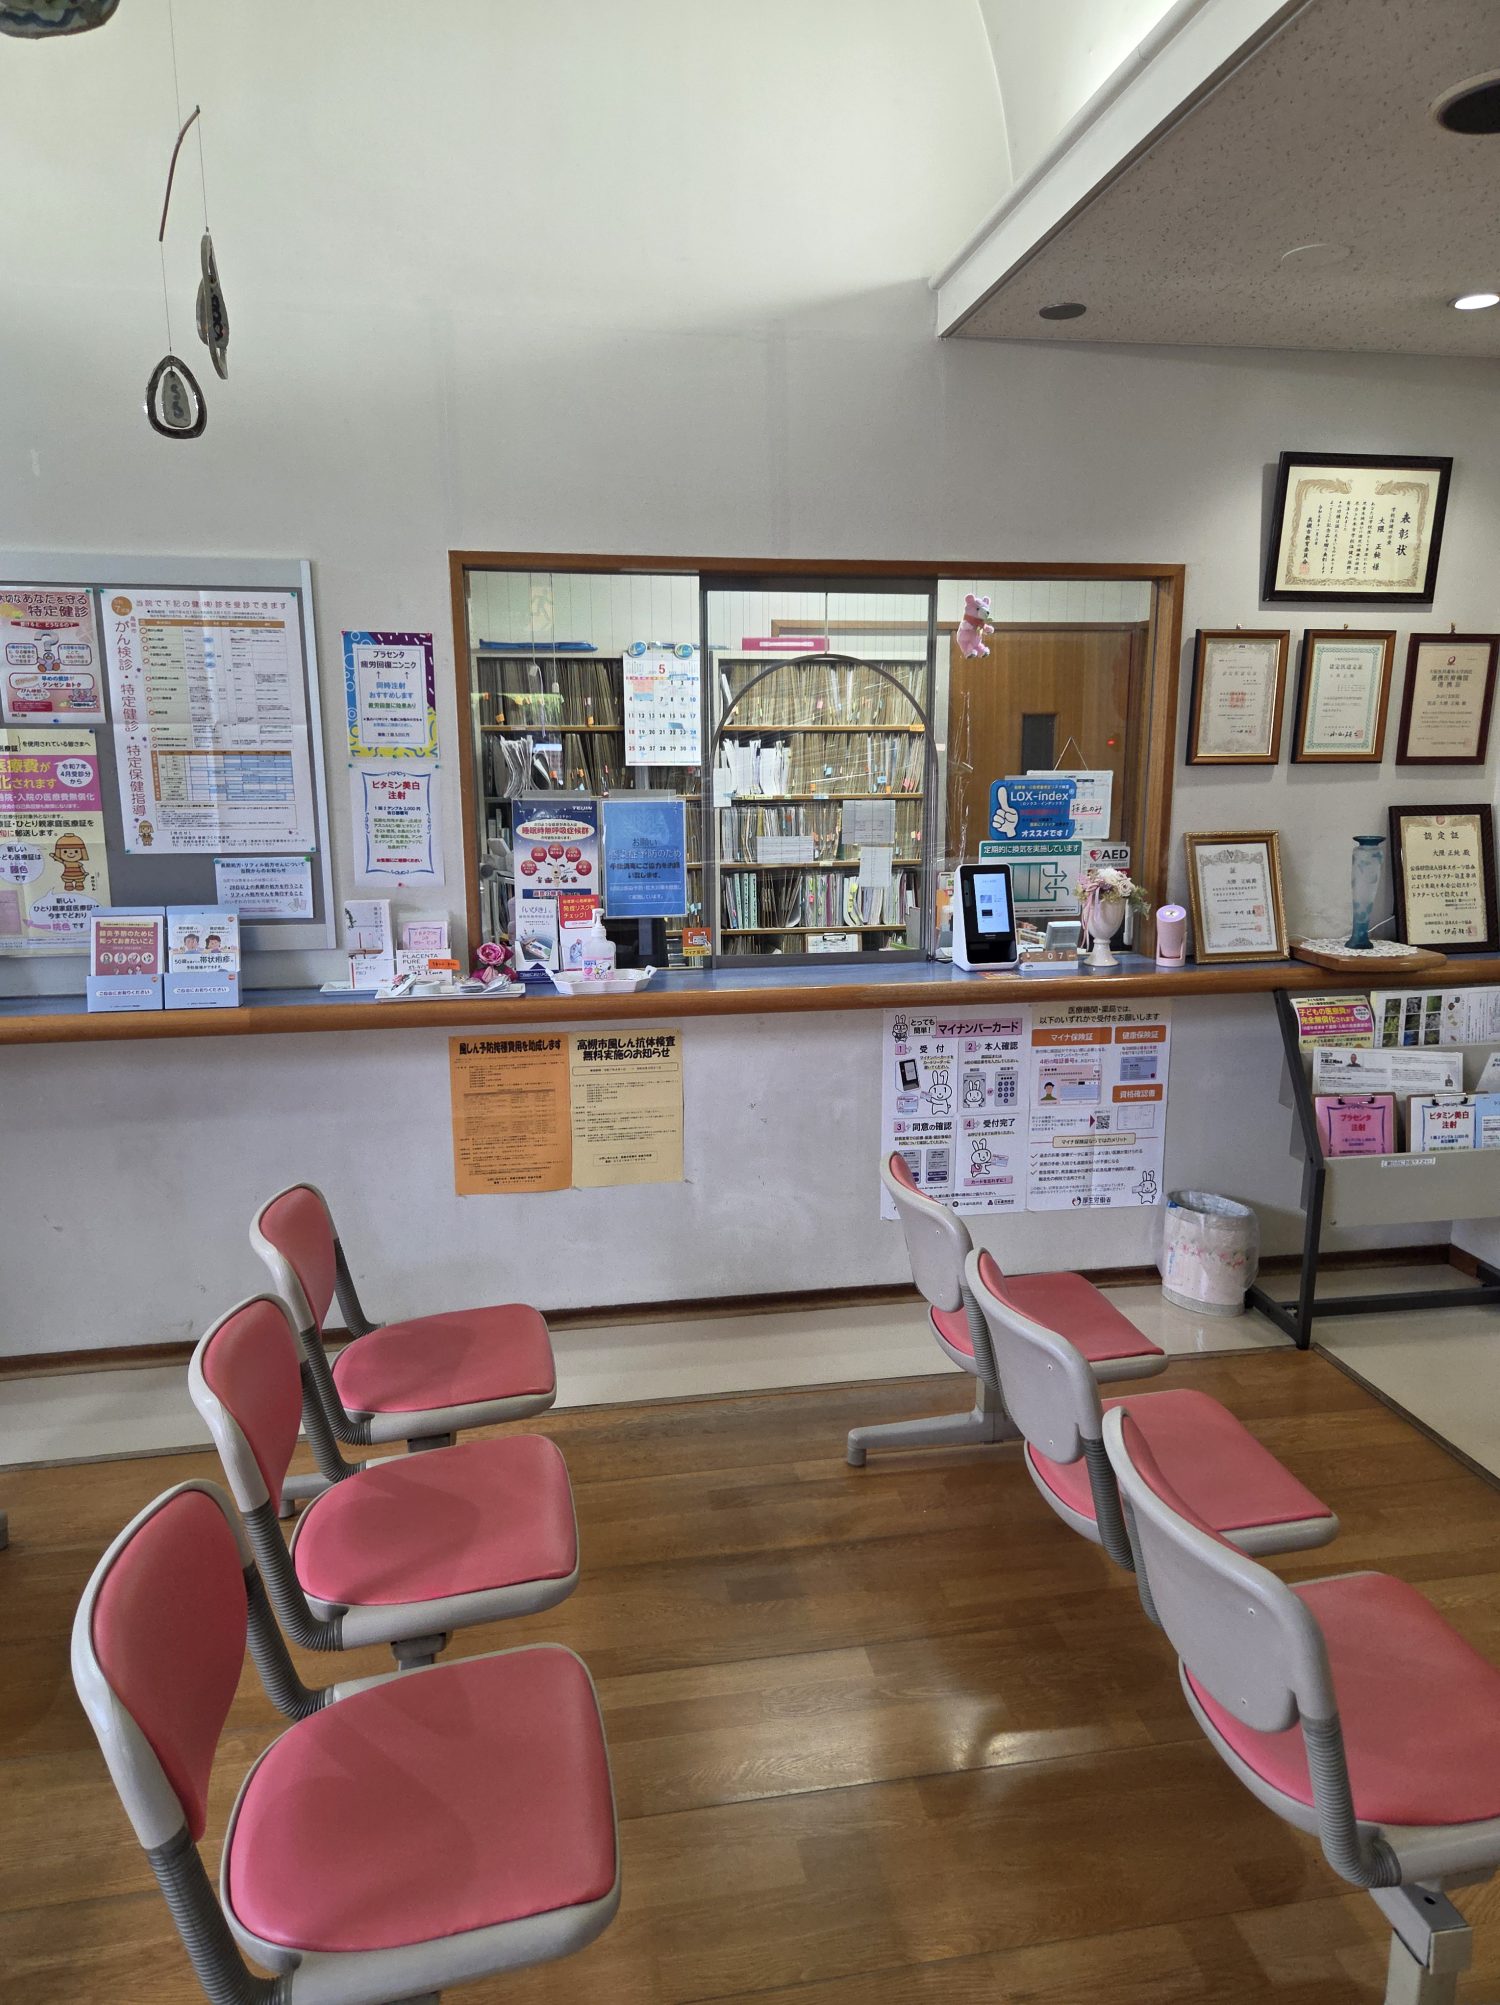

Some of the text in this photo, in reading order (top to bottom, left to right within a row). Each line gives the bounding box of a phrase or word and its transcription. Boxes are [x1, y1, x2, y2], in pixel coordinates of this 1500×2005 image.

[1396, 511, 1411, 556] 表彰状
[28, 605, 89, 618] 特定健診
[373, 650, 405, 659] プラセンタ
[360, 660, 417, 669] 疲労回復ニンニク
[658, 663, 666, 675] 5
[376, 681, 406, 690] 同時注射
[369, 691, 414, 700] おすすめします
[60, 770, 91, 778] 4月受診分
[372, 780, 420, 791] ビタミン美白
[388, 790, 407, 800] 注射
[1010, 791, 1069, 801] LOX-index
[521, 826, 589, 835] 睡眠時無呼吸症候群
[1423, 830, 1460, 841] 認定証
[632, 838, 658, 848] お願い
[608, 849, 682, 859] 感染症予防のため
[983, 844, 1079, 854] 定期的に換気を実施しています
[1101, 849, 1129, 860] AED
[1068, 1005, 1132, 1014] 医療機関・薬局では、
[910, 1018, 935, 1026] とっても
[1039, 1013, 1160, 1025] 以下のいずれかで受付をお願いします
[938, 1021, 1019, 1035] マイナンバーカード
[1050, 1032, 1093, 1042] マイナ保険証
[1122, 1030, 1159, 1040] 健康保険証
[459, 1038, 561, 1055] 風しん予防接種費用を助成します
[577, 1035, 676, 1051] 高槻市風しん抗体検査
[968, 1041, 1019, 1051] 2 本人確認
[583, 1047, 670, 1062] 無料実施のお知らせ
[1429, 1111, 1470, 1120] ビタミン美白
[912, 1122, 952, 1132] 同意の確認
[966, 1118, 1016, 1128] 4 受付完了
[1351, 1123, 1366, 1132] 注射
[1442, 1120, 1457, 1129] 注射
[1061, 1137, 1128, 1145] マイナ保険証ならではのメリット
[1082, 1196, 1112, 1204] 厚生労働省
